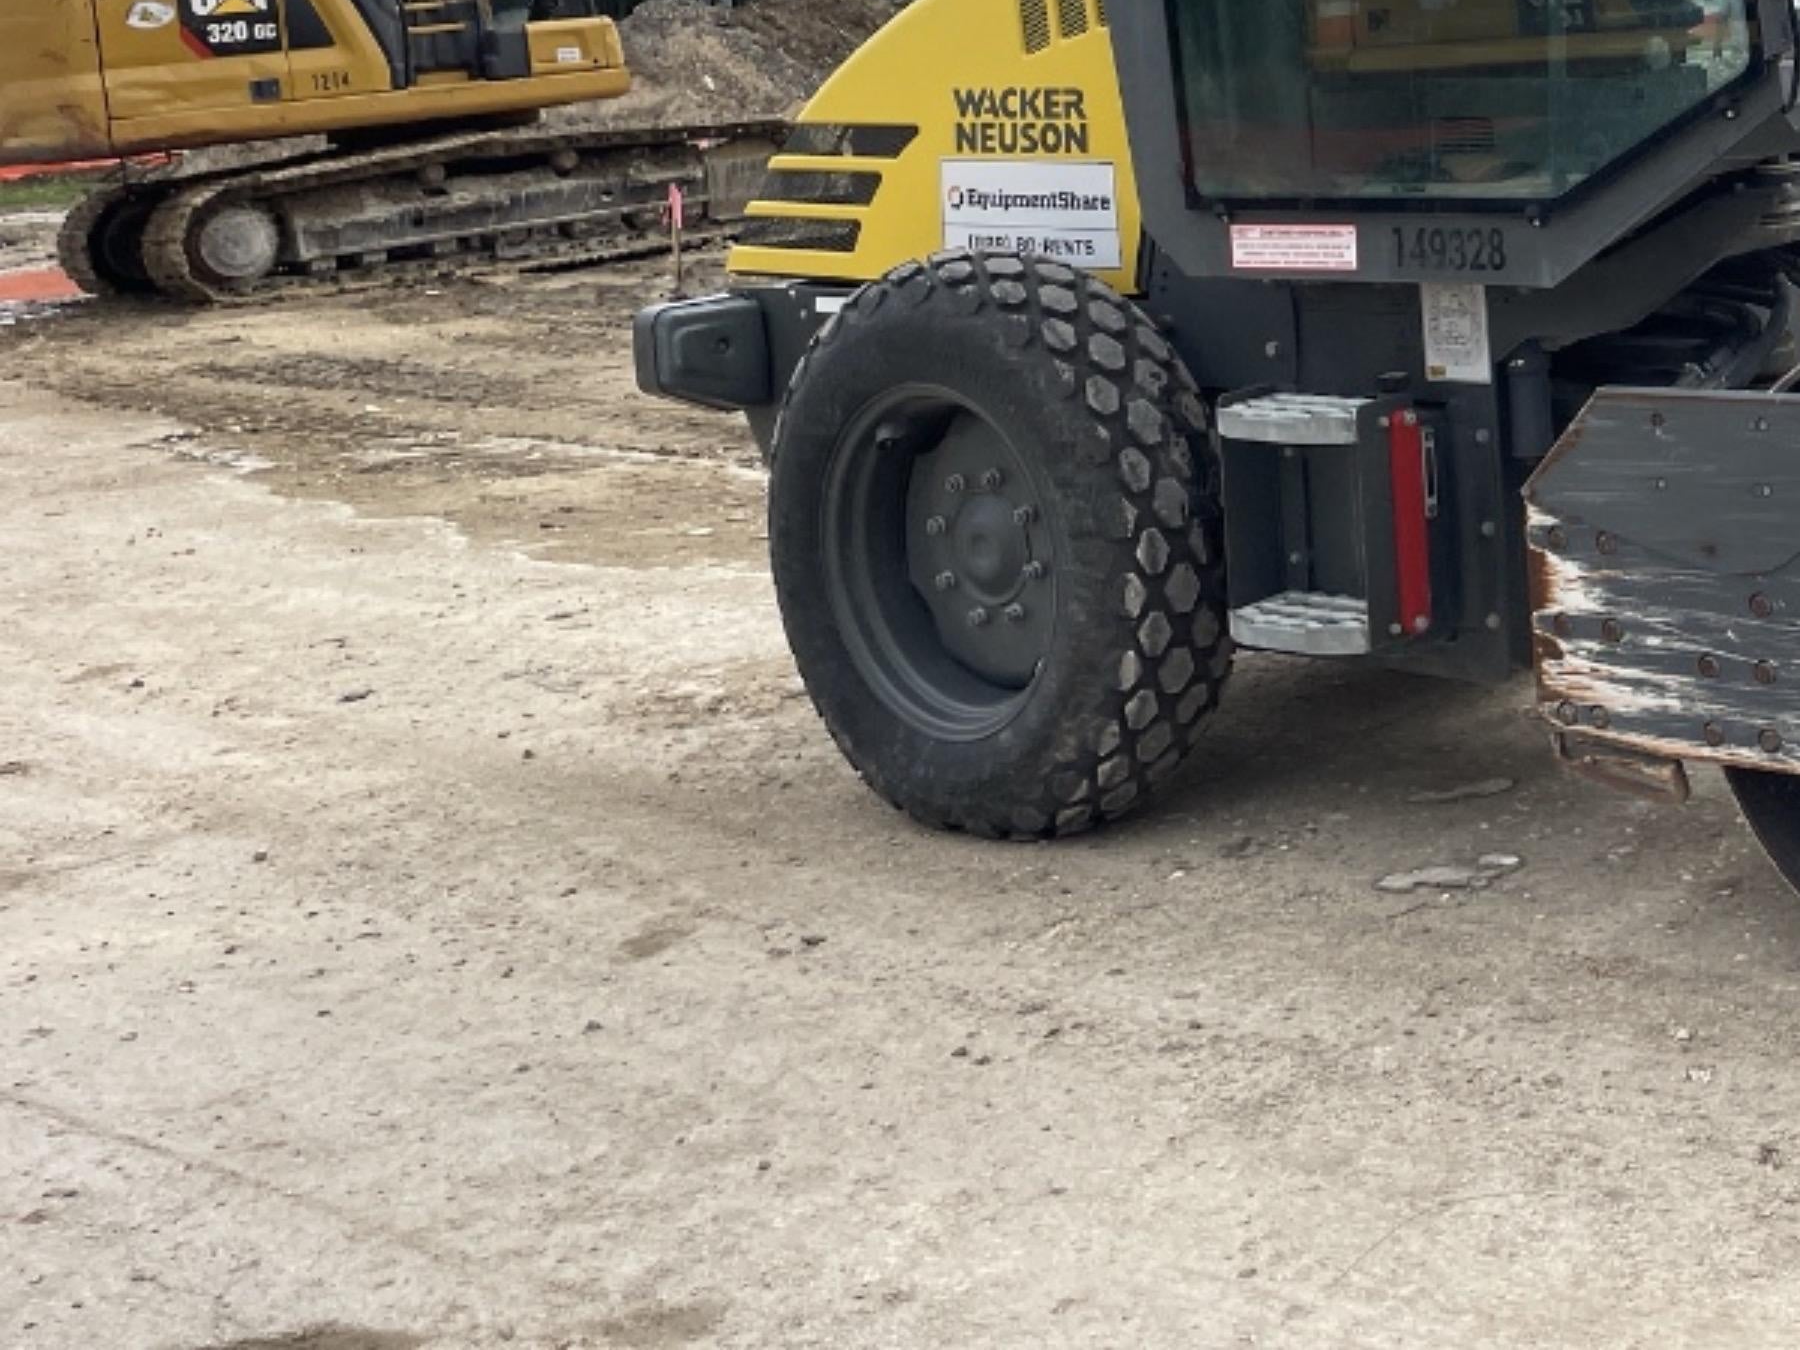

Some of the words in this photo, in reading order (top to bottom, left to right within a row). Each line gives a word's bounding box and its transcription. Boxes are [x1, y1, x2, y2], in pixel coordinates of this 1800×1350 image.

[206, 21, 248, 43] 320
[953, 87, 1087, 120] WACKER
[956, 122, 1089, 154] NEUSON
[966, 188, 1111, 211] EquipmentShare
[1391, 227, 1506, 271] 149328
